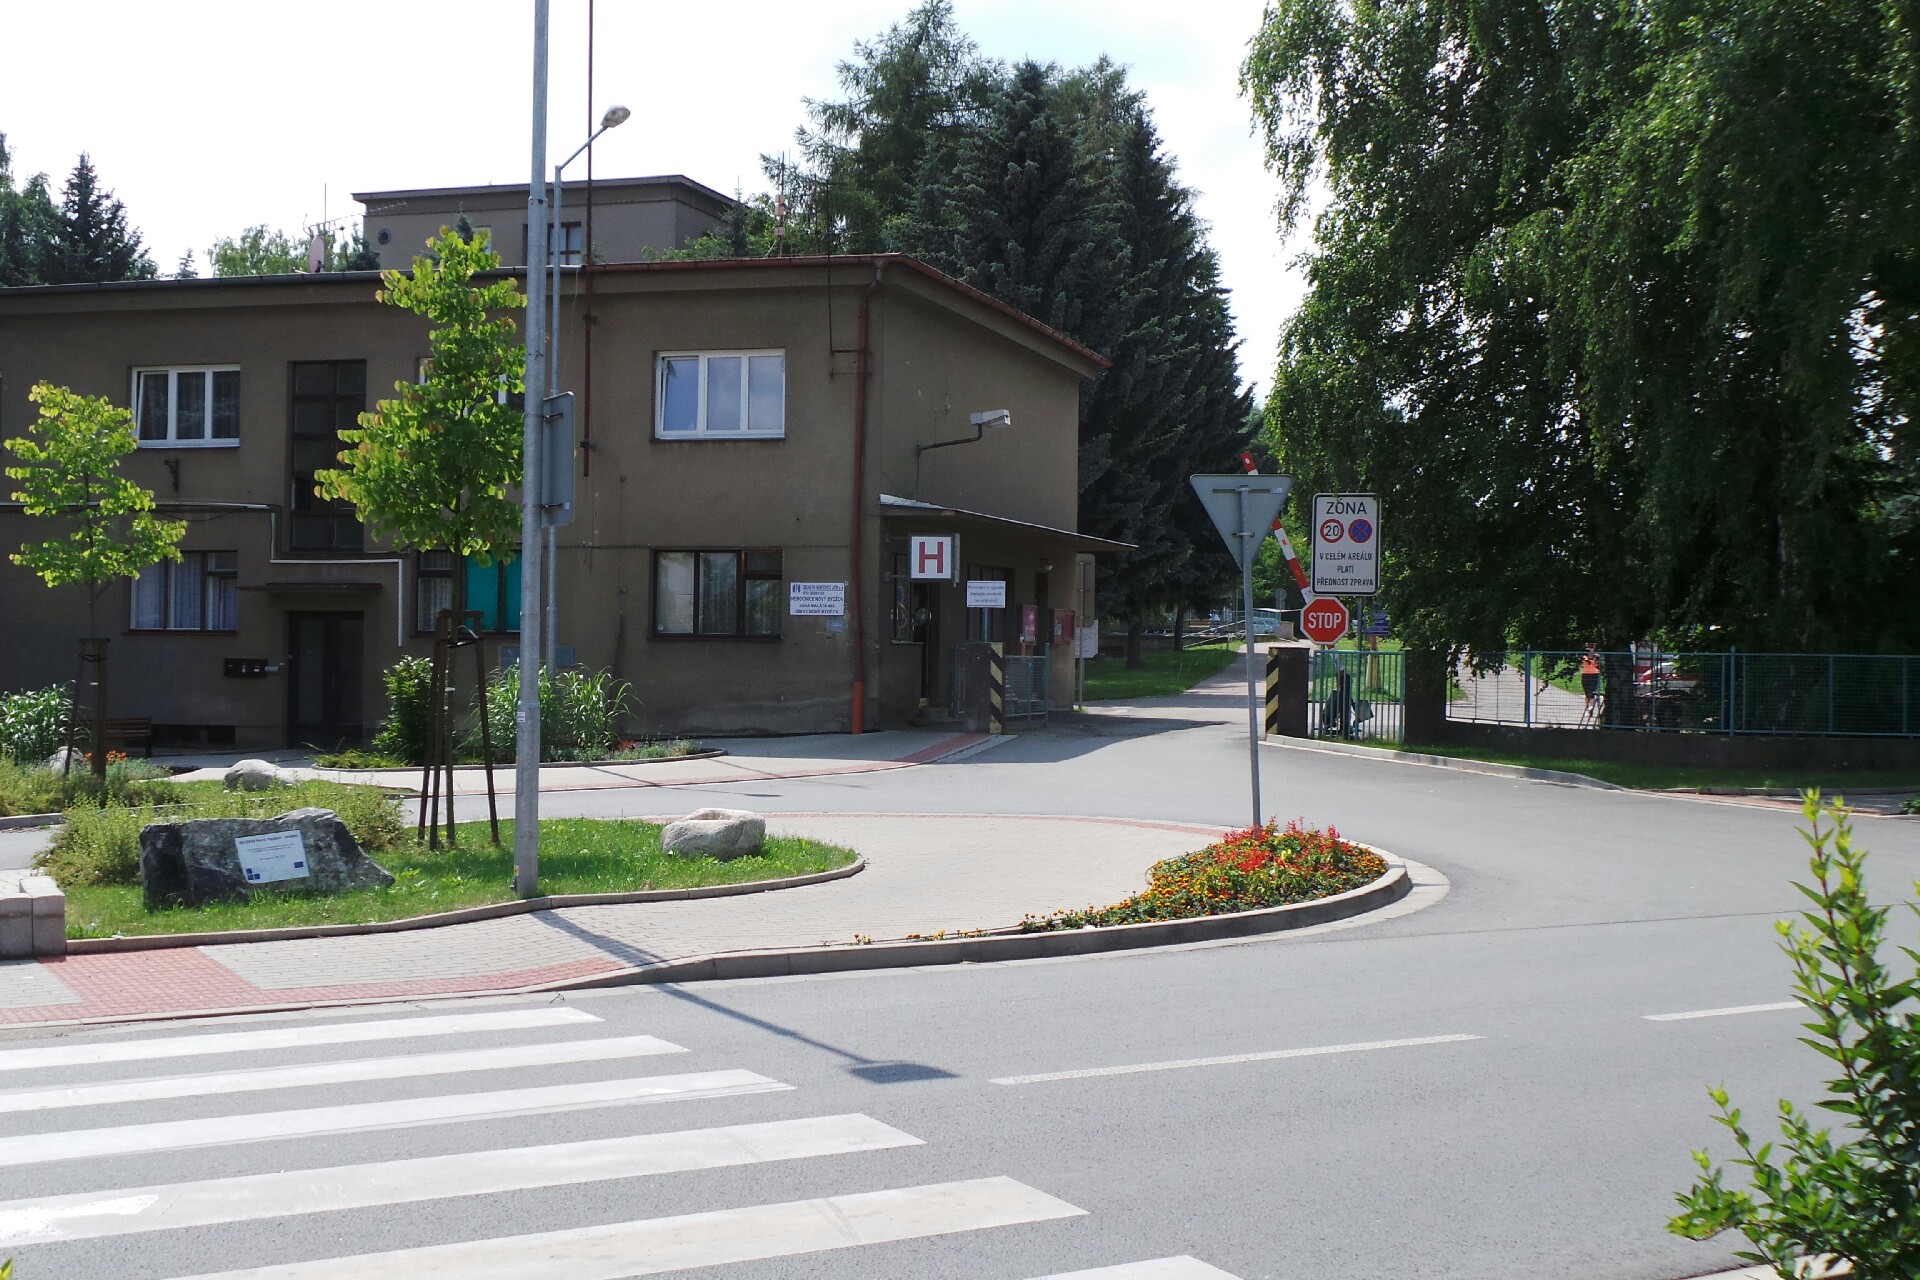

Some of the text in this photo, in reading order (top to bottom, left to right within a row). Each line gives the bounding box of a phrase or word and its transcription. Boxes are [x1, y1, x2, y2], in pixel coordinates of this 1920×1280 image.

[1326, 498, 1367, 515] ZÓNA
[1325, 525, 1339, 537] 20
[918, 541, 944, 574] H
[1320, 551, 1372, 561] V CELÉM AREÁLU
[1337, 564, 1354, 574] PLATÍ
[1316, 577, 1374, 587] PŘEDNOST ZPRAVA
[1308, 612, 1342, 629] STOP
